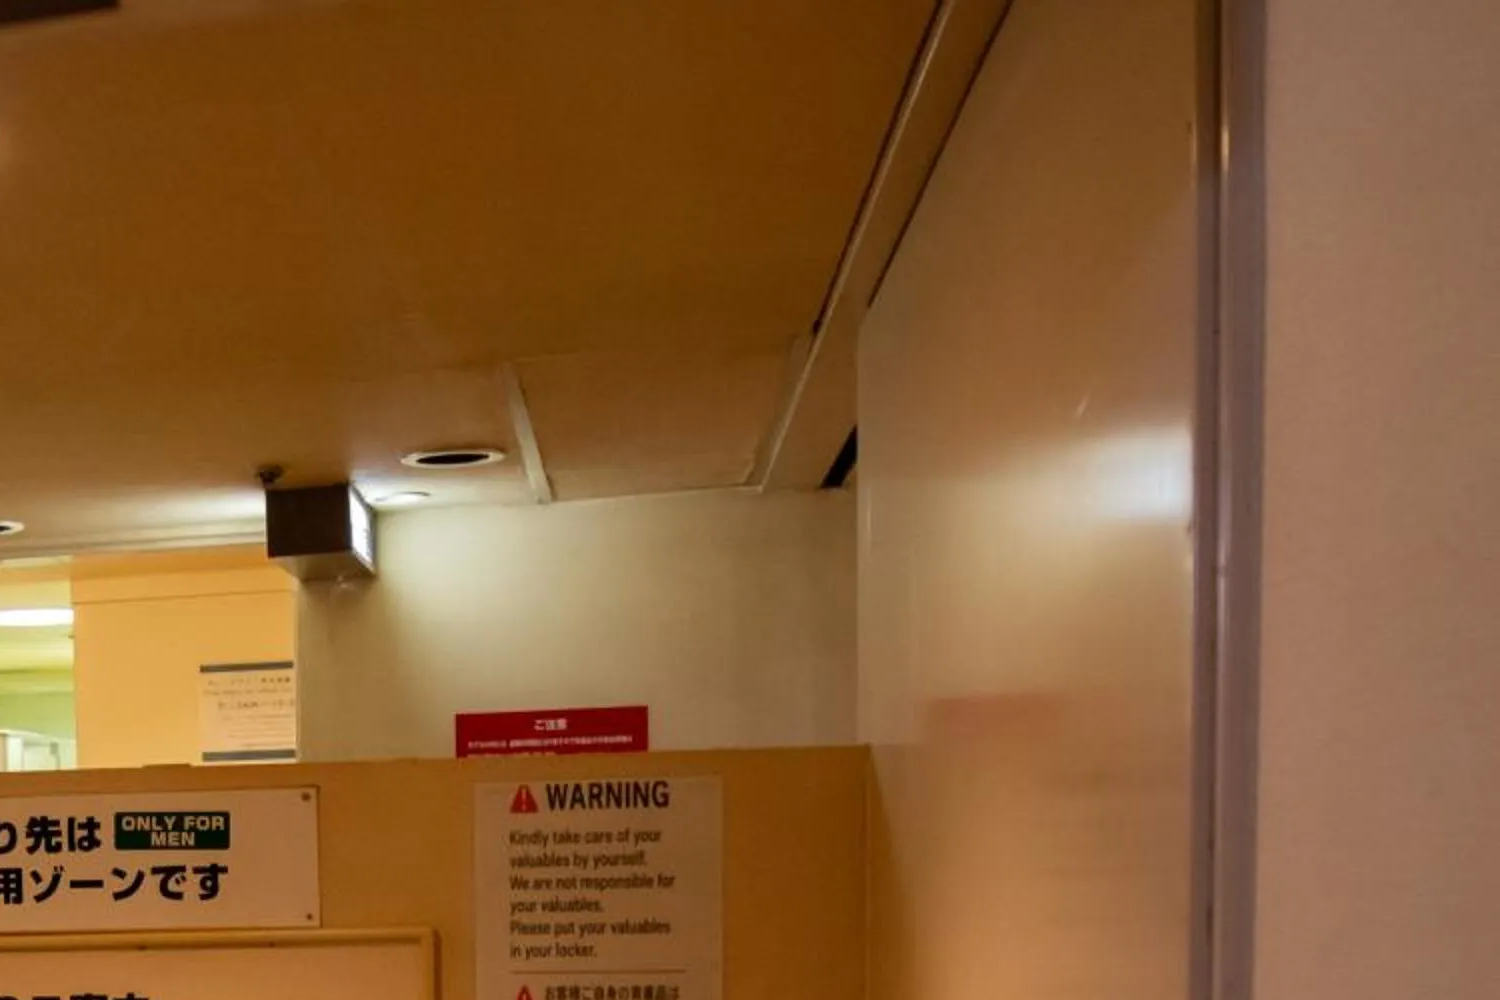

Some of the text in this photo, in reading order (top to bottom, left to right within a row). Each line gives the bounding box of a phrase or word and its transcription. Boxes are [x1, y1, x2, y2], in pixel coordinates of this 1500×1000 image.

[546, 781, 670, 811] WARNING
[121, 815, 225, 831] ONLY FOR
[151, 831, 195, 847] MEN
[509, 828, 662, 848] Kindly take care of your
[509, 852, 570, 869] valuables
[573, 852, 589, 870] by
[509, 872, 675, 893] We are not responsible for
[509, 900, 537, 917] your
[509, 916, 672, 939] Please put your valuables
[509, 942, 521, 958] in
[525, 944, 551, 961] your
